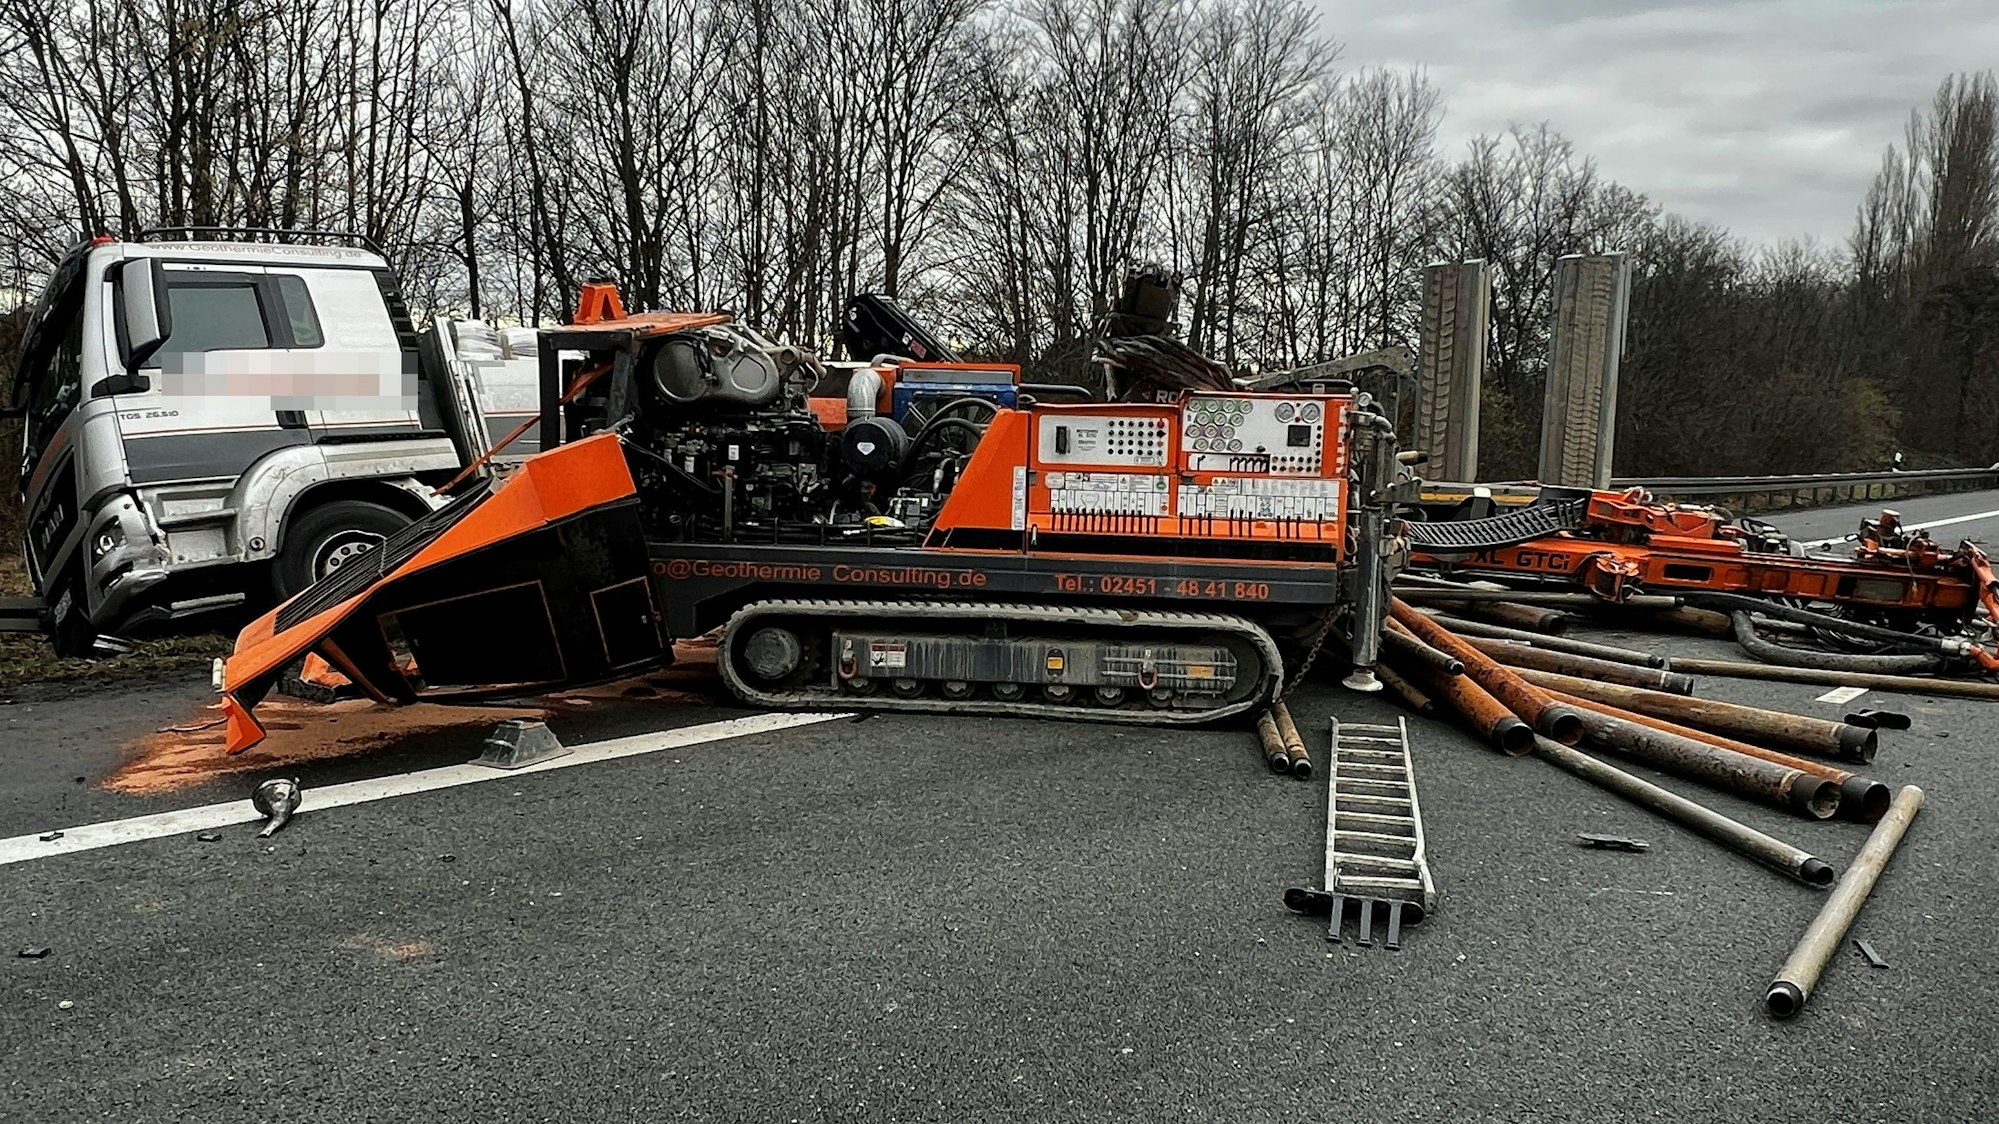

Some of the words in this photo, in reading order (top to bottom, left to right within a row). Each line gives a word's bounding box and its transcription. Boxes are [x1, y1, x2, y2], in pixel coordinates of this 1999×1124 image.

[1516, 550, 1571, 571] GTCi
[832, 564, 987, 588] Consulting.de
[1055, 573, 1094, 593] Tel.:
[1100, 576, 1157, 595] 02451
[1176, 579, 1200, 597] 48
[1205, 580, 1228, 599] 41
[1234, 583, 1270, 600] 840
